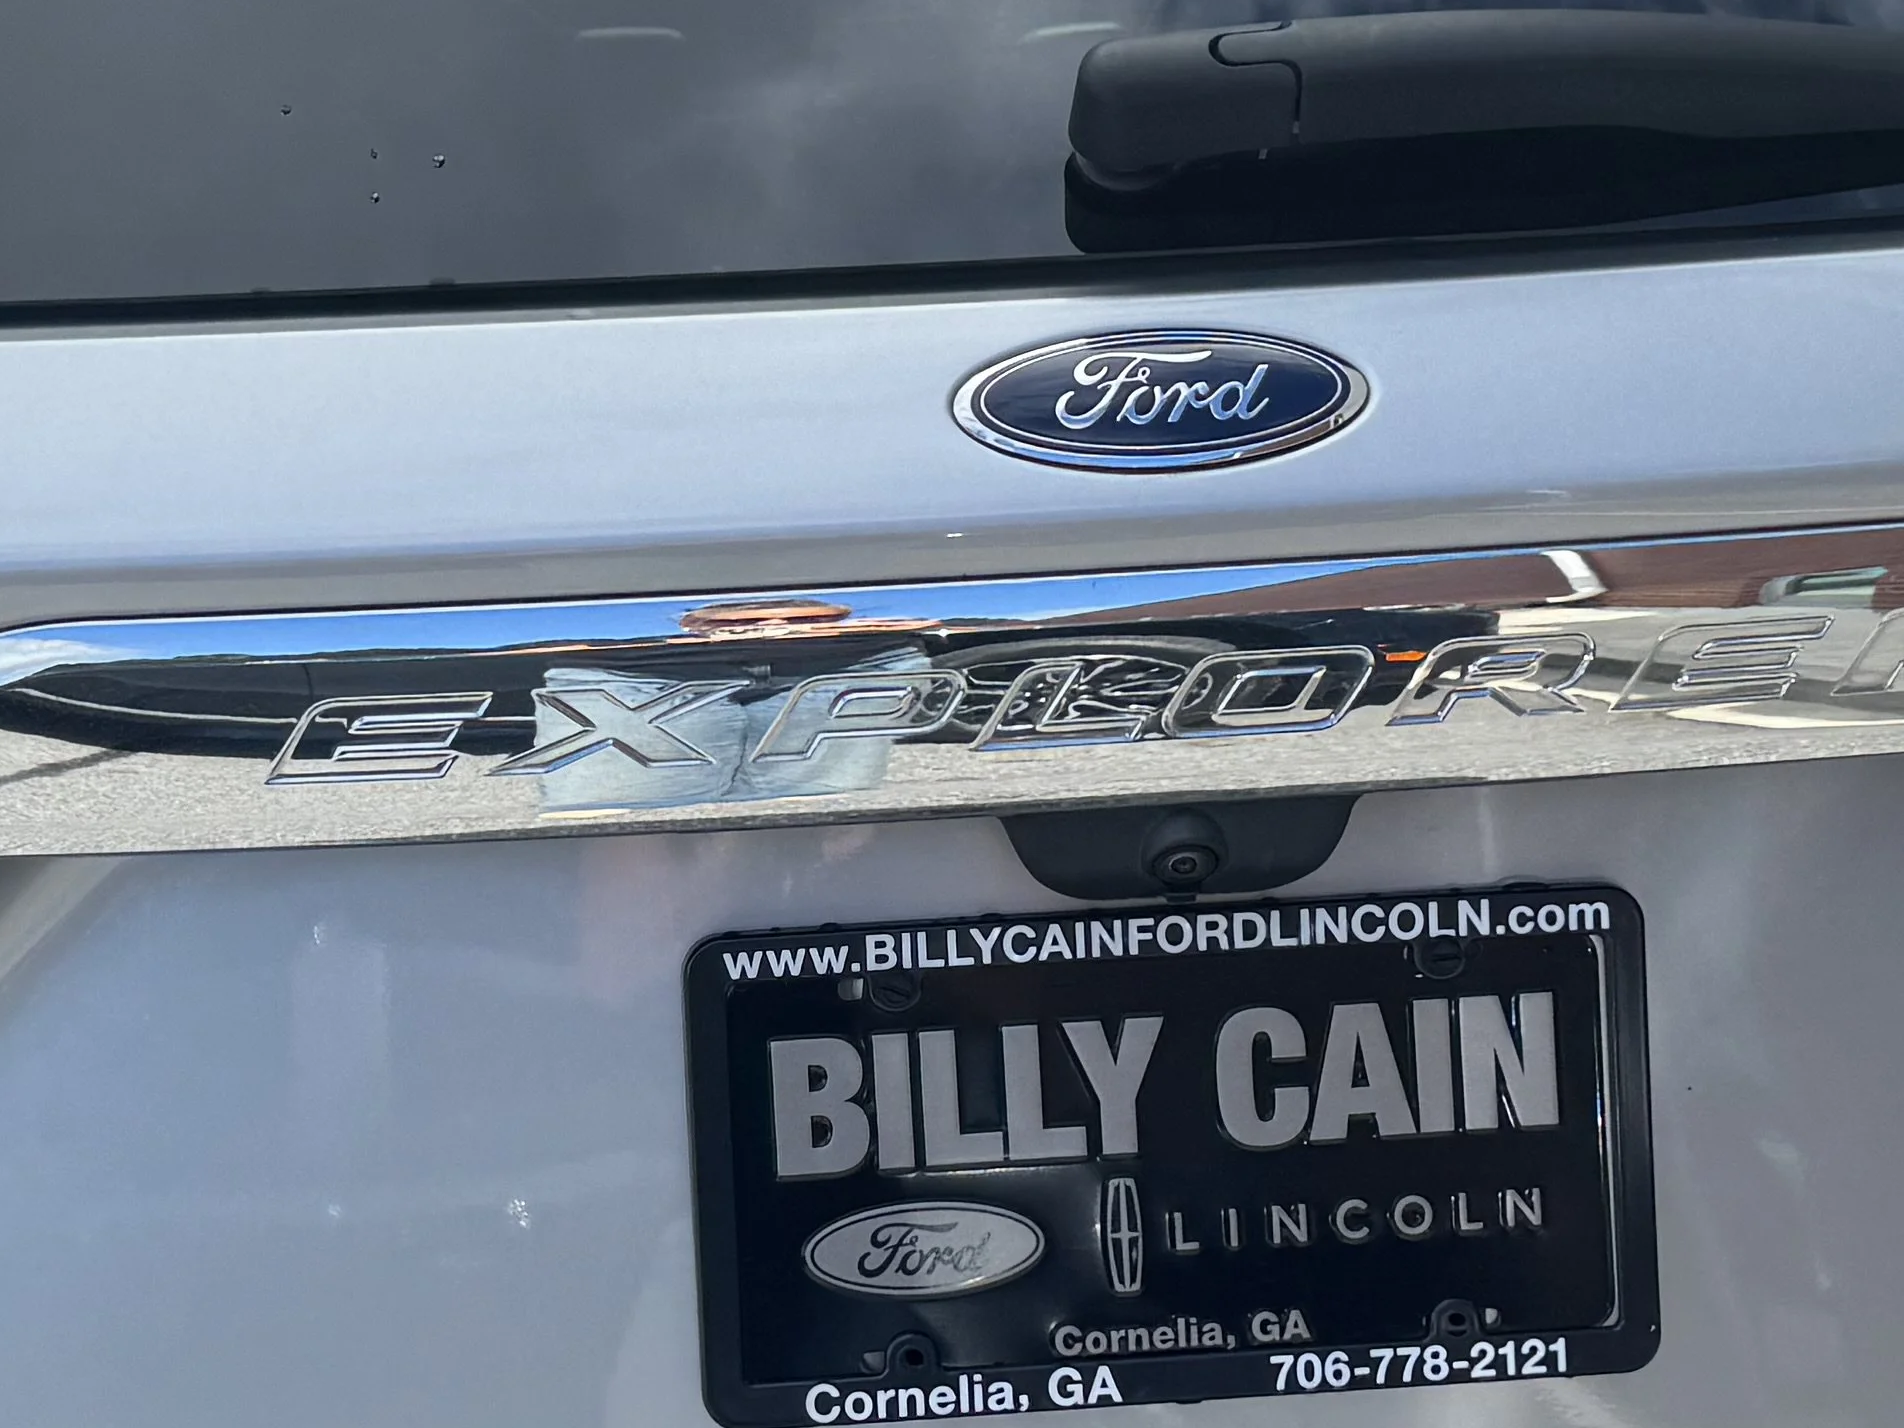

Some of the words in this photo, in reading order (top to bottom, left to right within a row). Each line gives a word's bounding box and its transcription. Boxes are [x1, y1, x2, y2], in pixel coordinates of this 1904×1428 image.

[1053, 349, 1271, 430] Ford
[723, 895, 1612, 982] www.BILLYCAINFORDLINCOLN.com
[766, 1014, 1166, 1182] BILLY
[1213, 989, 1561, 1152] CAIN
[856, 1219, 992, 1280] Ford
[1170, 1185, 1545, 1254] LINCOLN
[1052, 1314, 1237, 1358] Cornelia,
[1249, 1308, 1311, 1348] GA
[1268, 1340, 1570, 1393] 706-778-2121
[804, 1372, 1032, 1425] Cornelia,
[1047, 1365, 1124, 1408] GA
